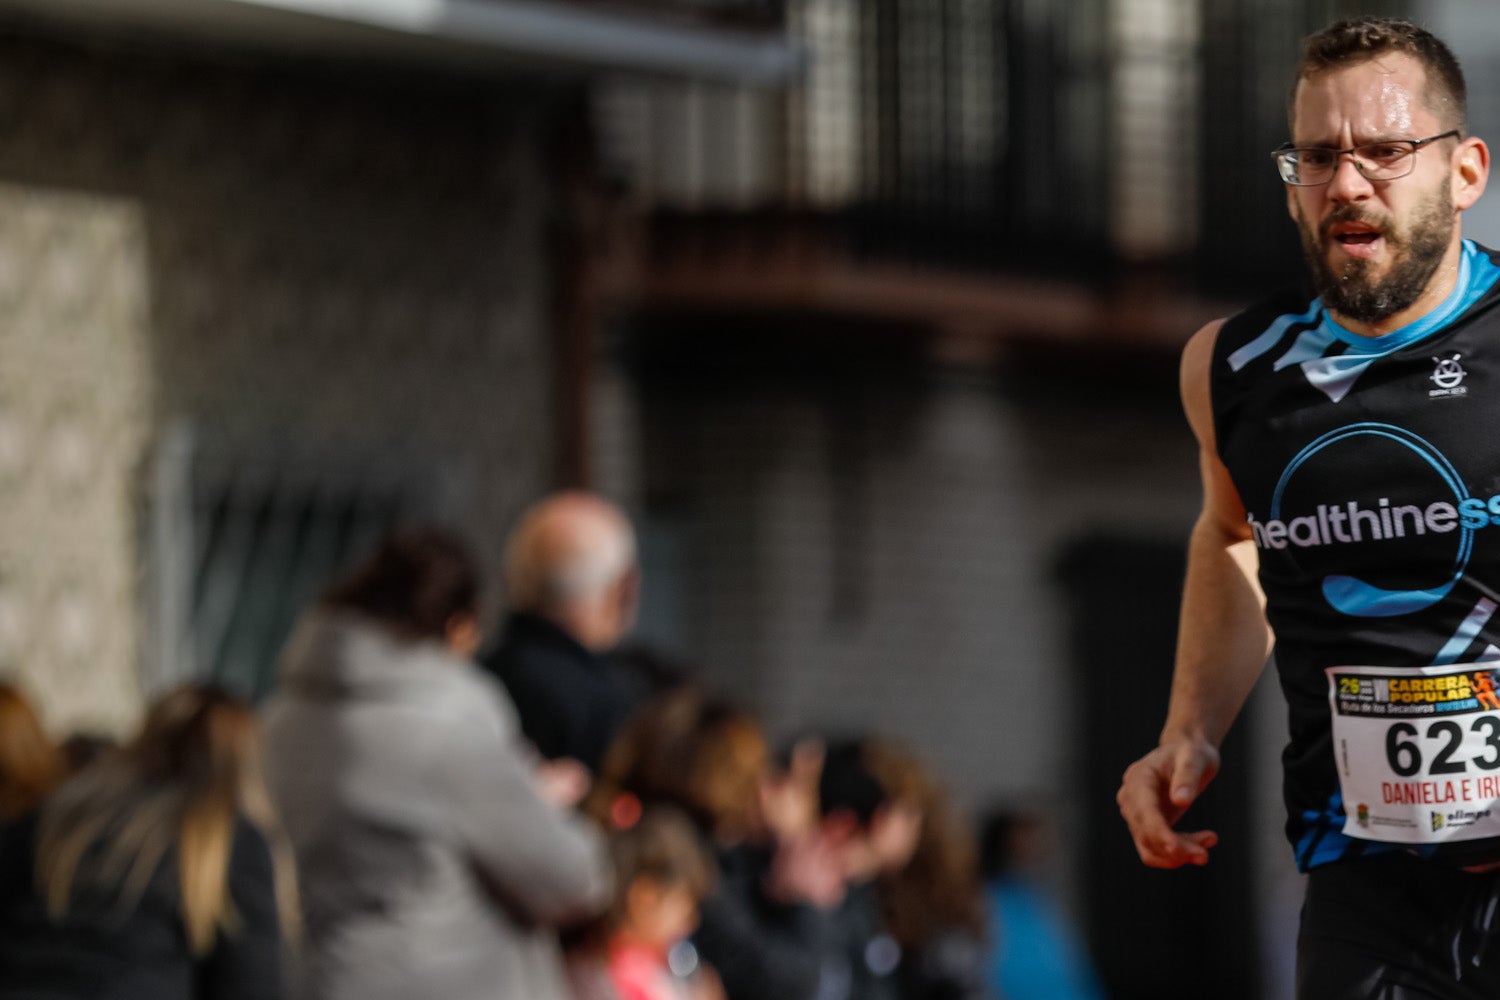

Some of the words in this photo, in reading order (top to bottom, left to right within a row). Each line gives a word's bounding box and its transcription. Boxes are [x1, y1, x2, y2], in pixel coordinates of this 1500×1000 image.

[1340, 677, 1360, 694] 26
[1388, 674, 1471, 692] CARRERA
[1389, 687, 1472, 704] POPULAR
[1381, 781, 1456, 805] DANIELA
[1461, 779, 1472, 801] E
